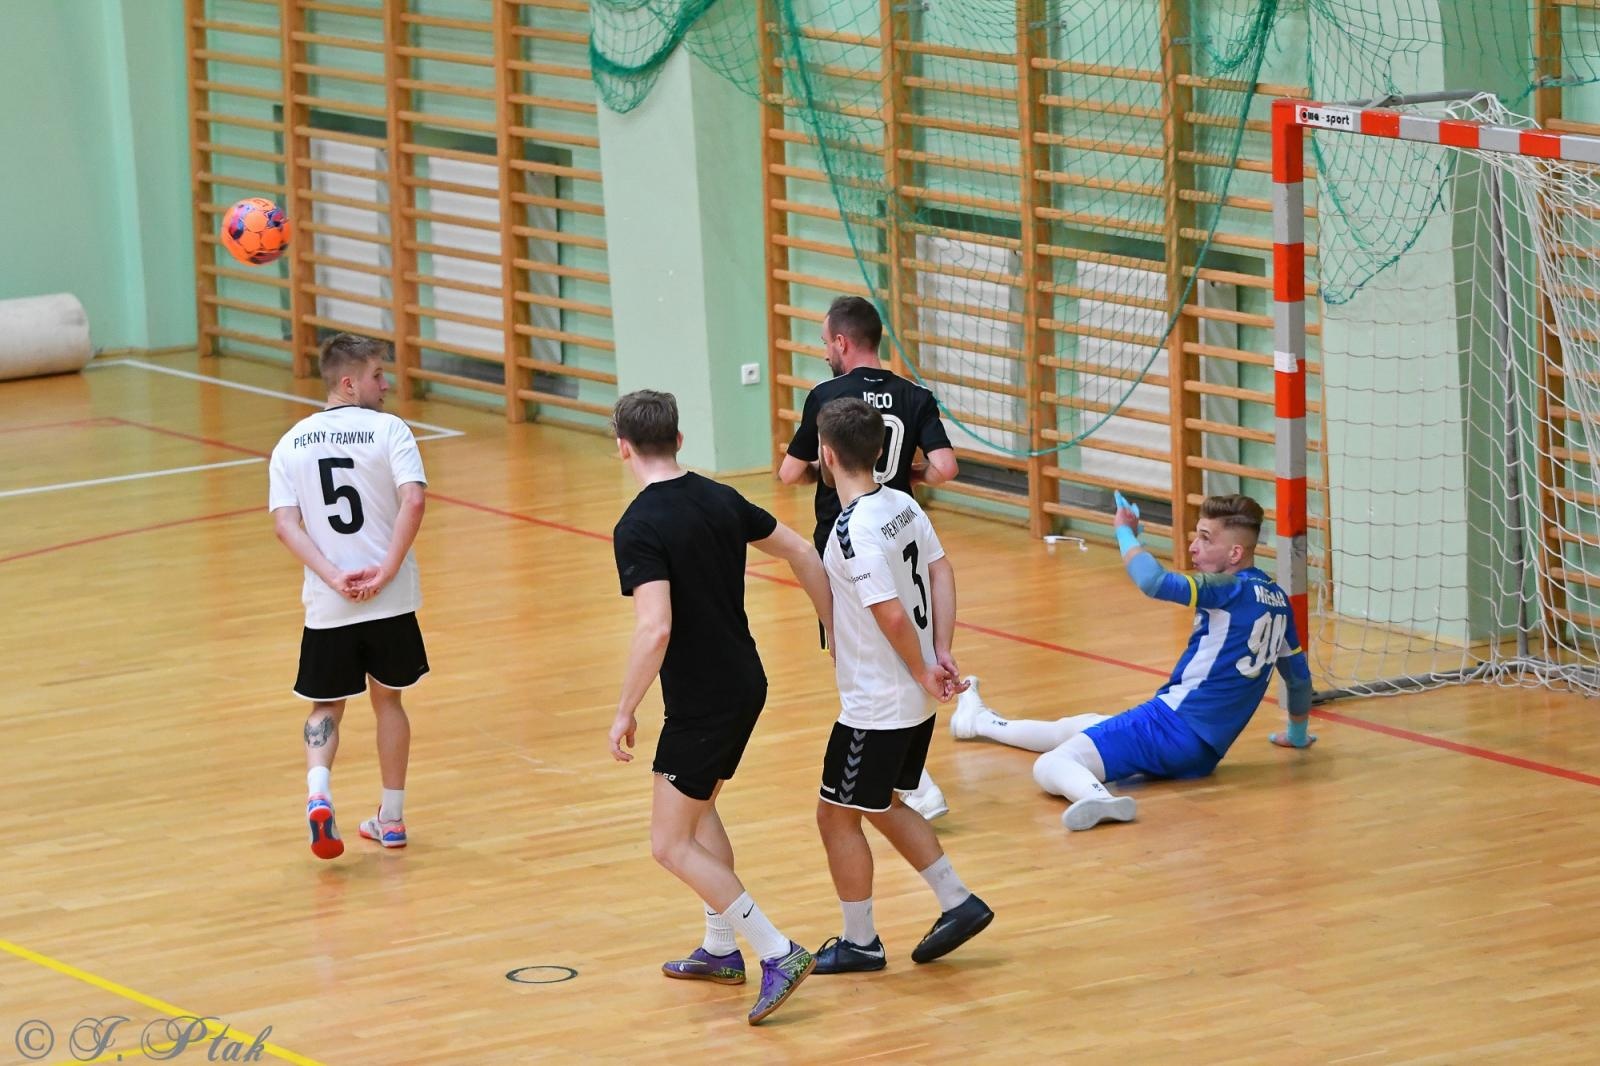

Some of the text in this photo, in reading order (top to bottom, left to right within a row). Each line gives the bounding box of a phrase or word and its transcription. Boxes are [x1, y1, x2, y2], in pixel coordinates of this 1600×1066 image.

[294, 431, 375, 449] PIĘKNY TRAWNIK
[318, 457, 365, 535] 5
[902, 540, 928, 630] 3
